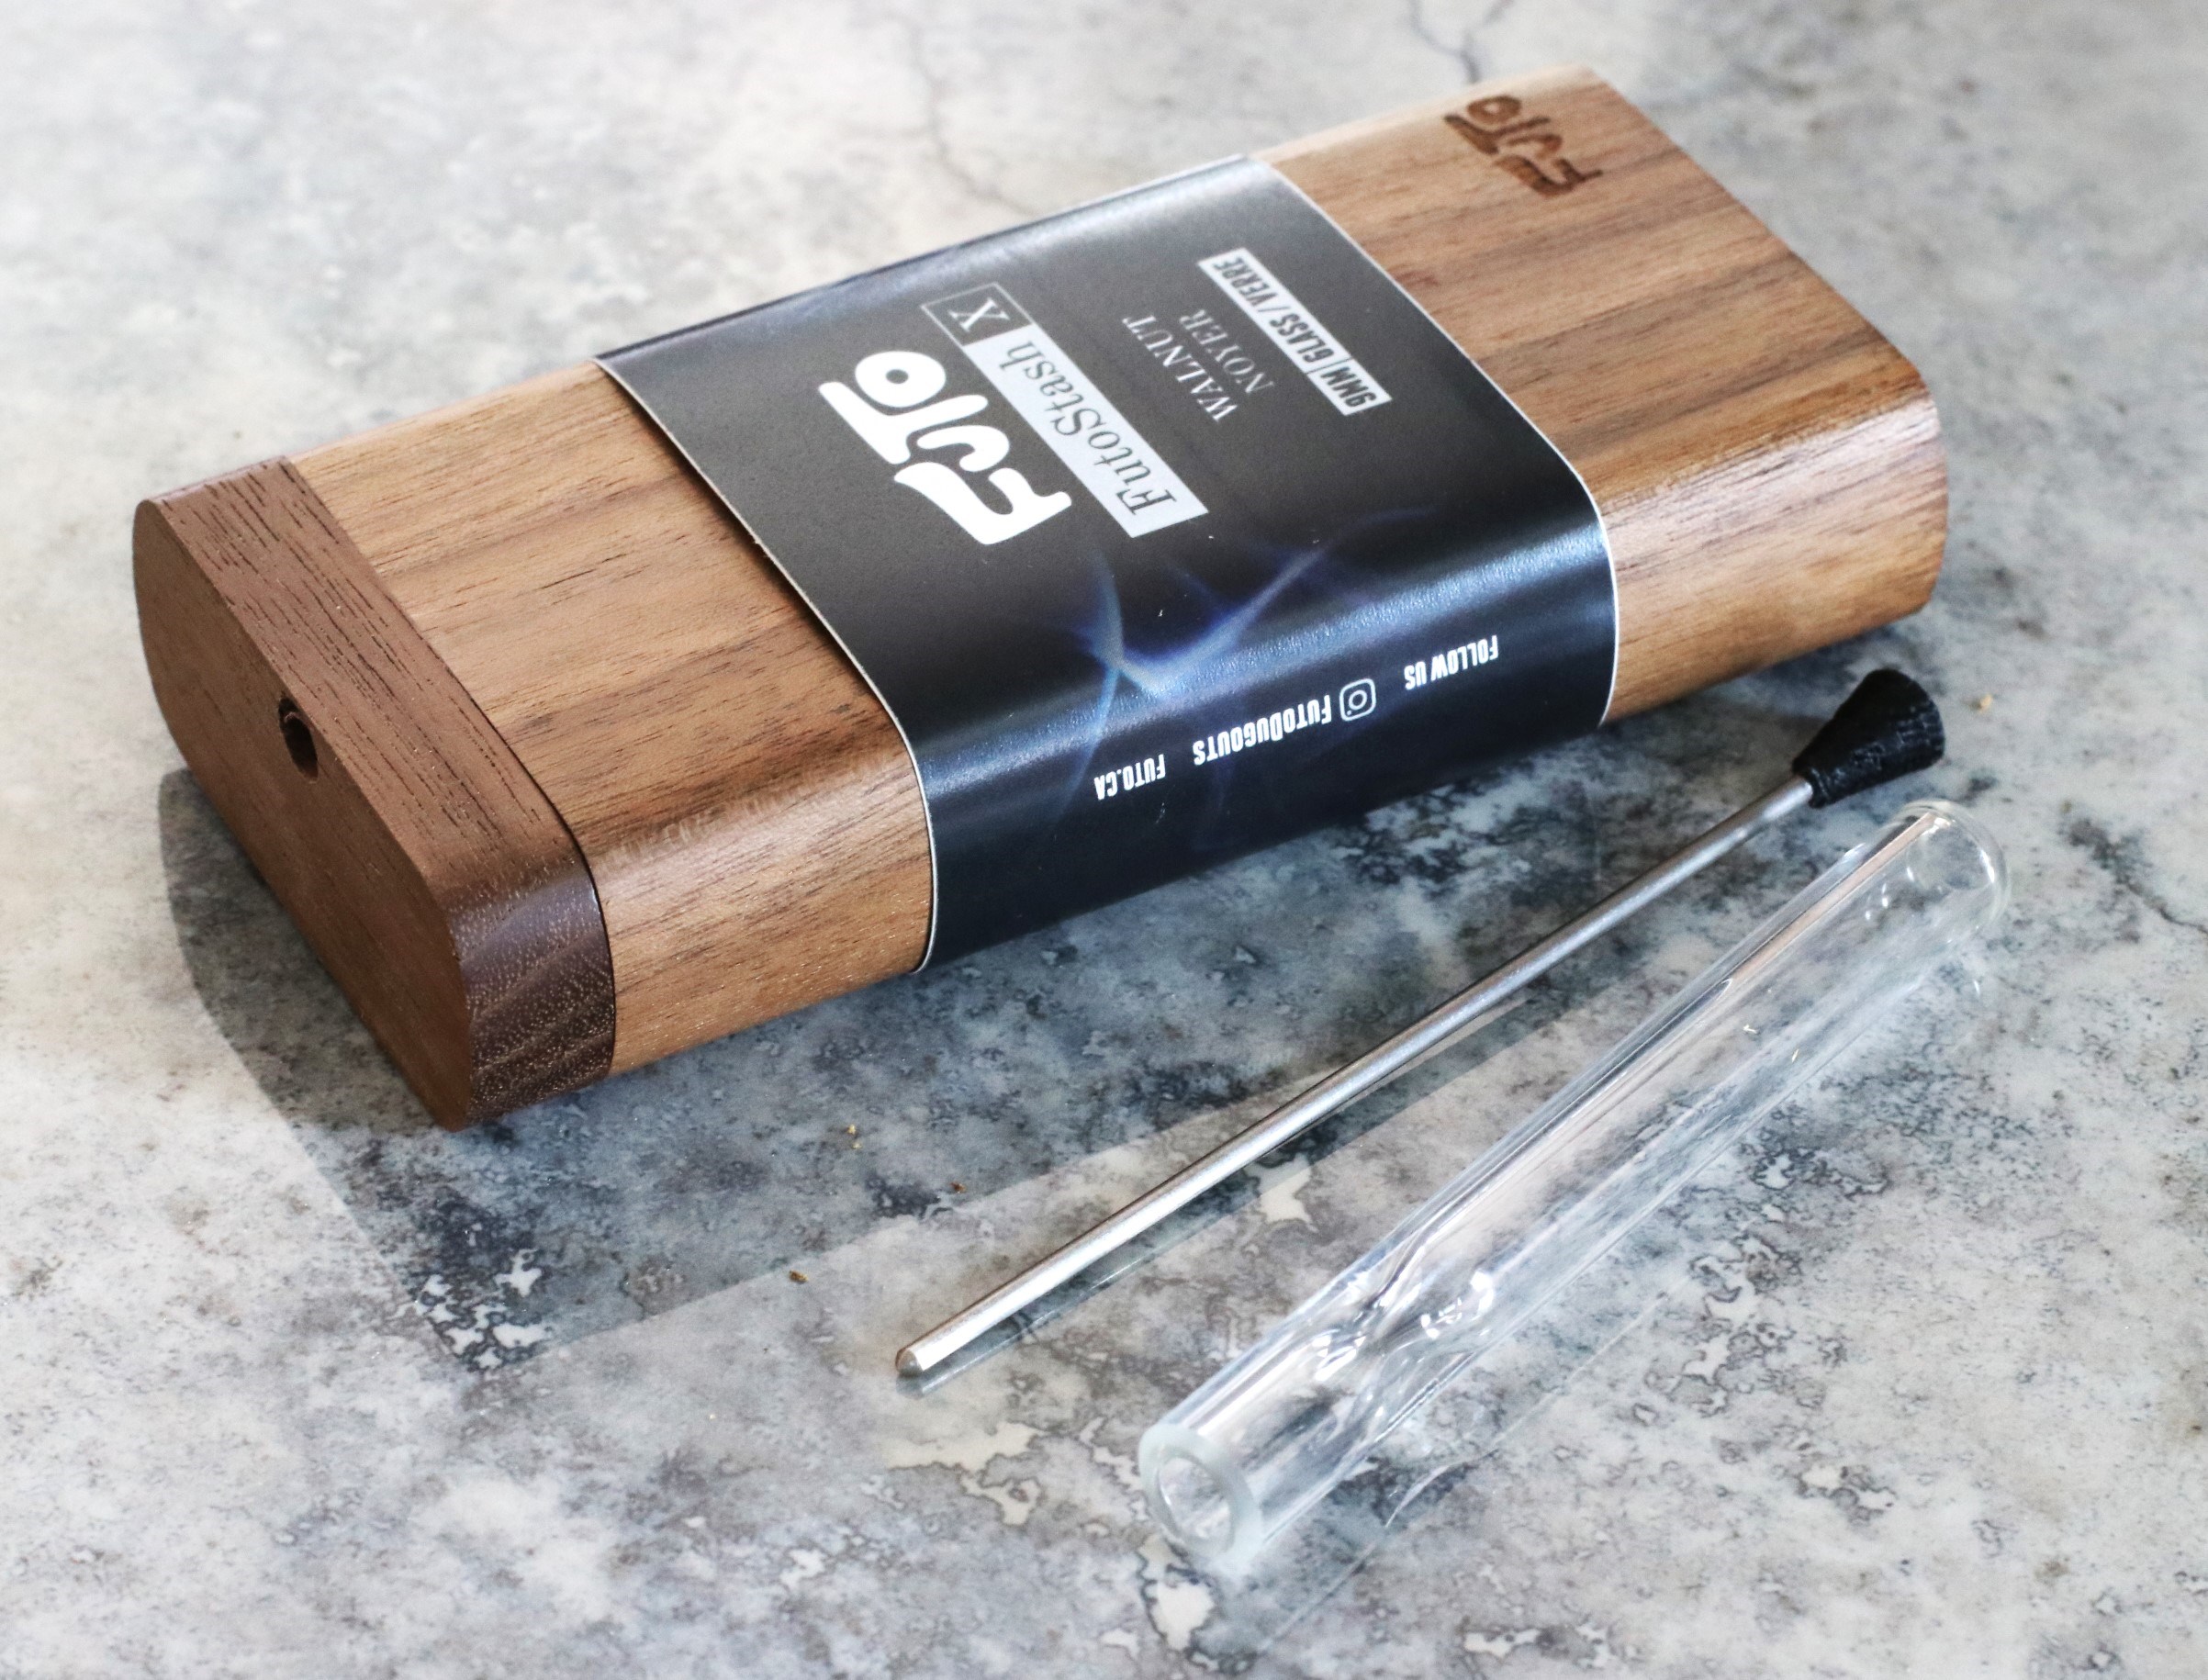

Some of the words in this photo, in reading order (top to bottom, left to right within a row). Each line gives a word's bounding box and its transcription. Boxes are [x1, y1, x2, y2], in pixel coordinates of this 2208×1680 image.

[1213, 256, 1279, 308] VERRE
[947, 297, 1011, 332] X
[1270, 312, 1335, 364] GLASS
[1122, 315, 1238, 422] WALNUT
[1179, 309, 1274, 394] NOYER
[1319, 366, 1377, 408] 9MM
[999, 341, 1178, 517] FutoStash
[1405, 660, 1428, 690] US
[1430, 635, 1499, 681] FOLLOW
[1094, 754, 1167, 800] FUTO.CA
